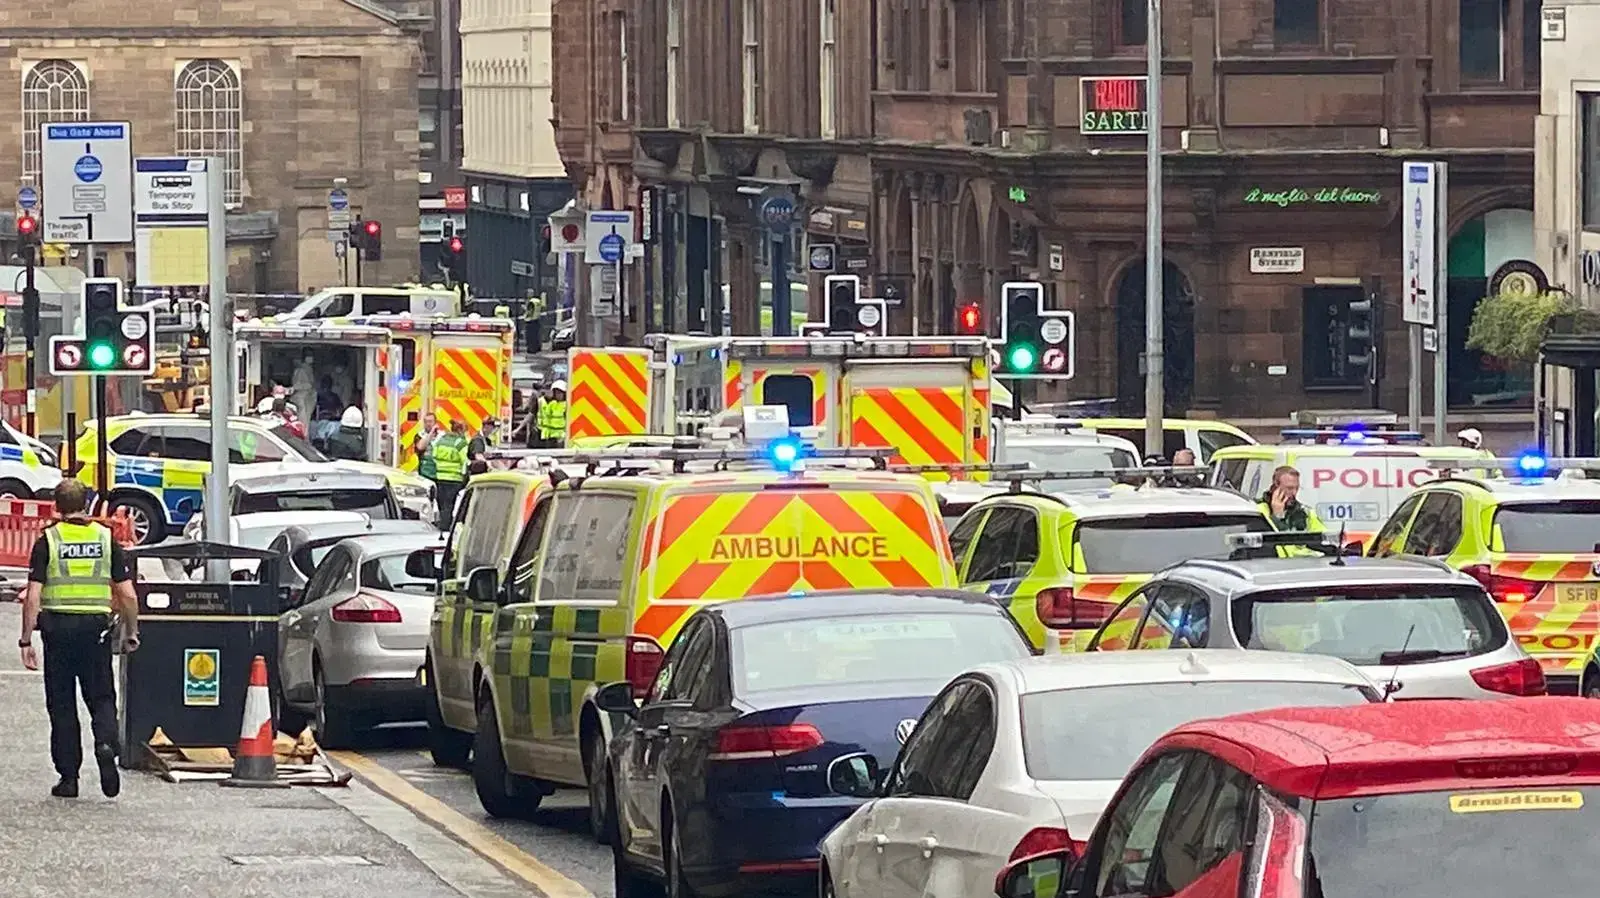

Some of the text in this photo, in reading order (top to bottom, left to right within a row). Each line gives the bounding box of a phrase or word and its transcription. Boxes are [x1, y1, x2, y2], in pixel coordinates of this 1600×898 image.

[1084, 111, 1148, 129] SARTI
[50, 128, 121, 137] Bus Gate Ahead
[148, 190, 195, 200] Temporary
[152, 201, 193, 210] Bus Stop
[47, 222, 83, 231] Through
[51, 231, 79, 239] traffic
[1313, 468, 1459, 489] POLIC
[1328, 504, 1353, 519] 101
[59, 544, 102, 558] POLICE
[711, 536, 888, 559] AMBULANCE
